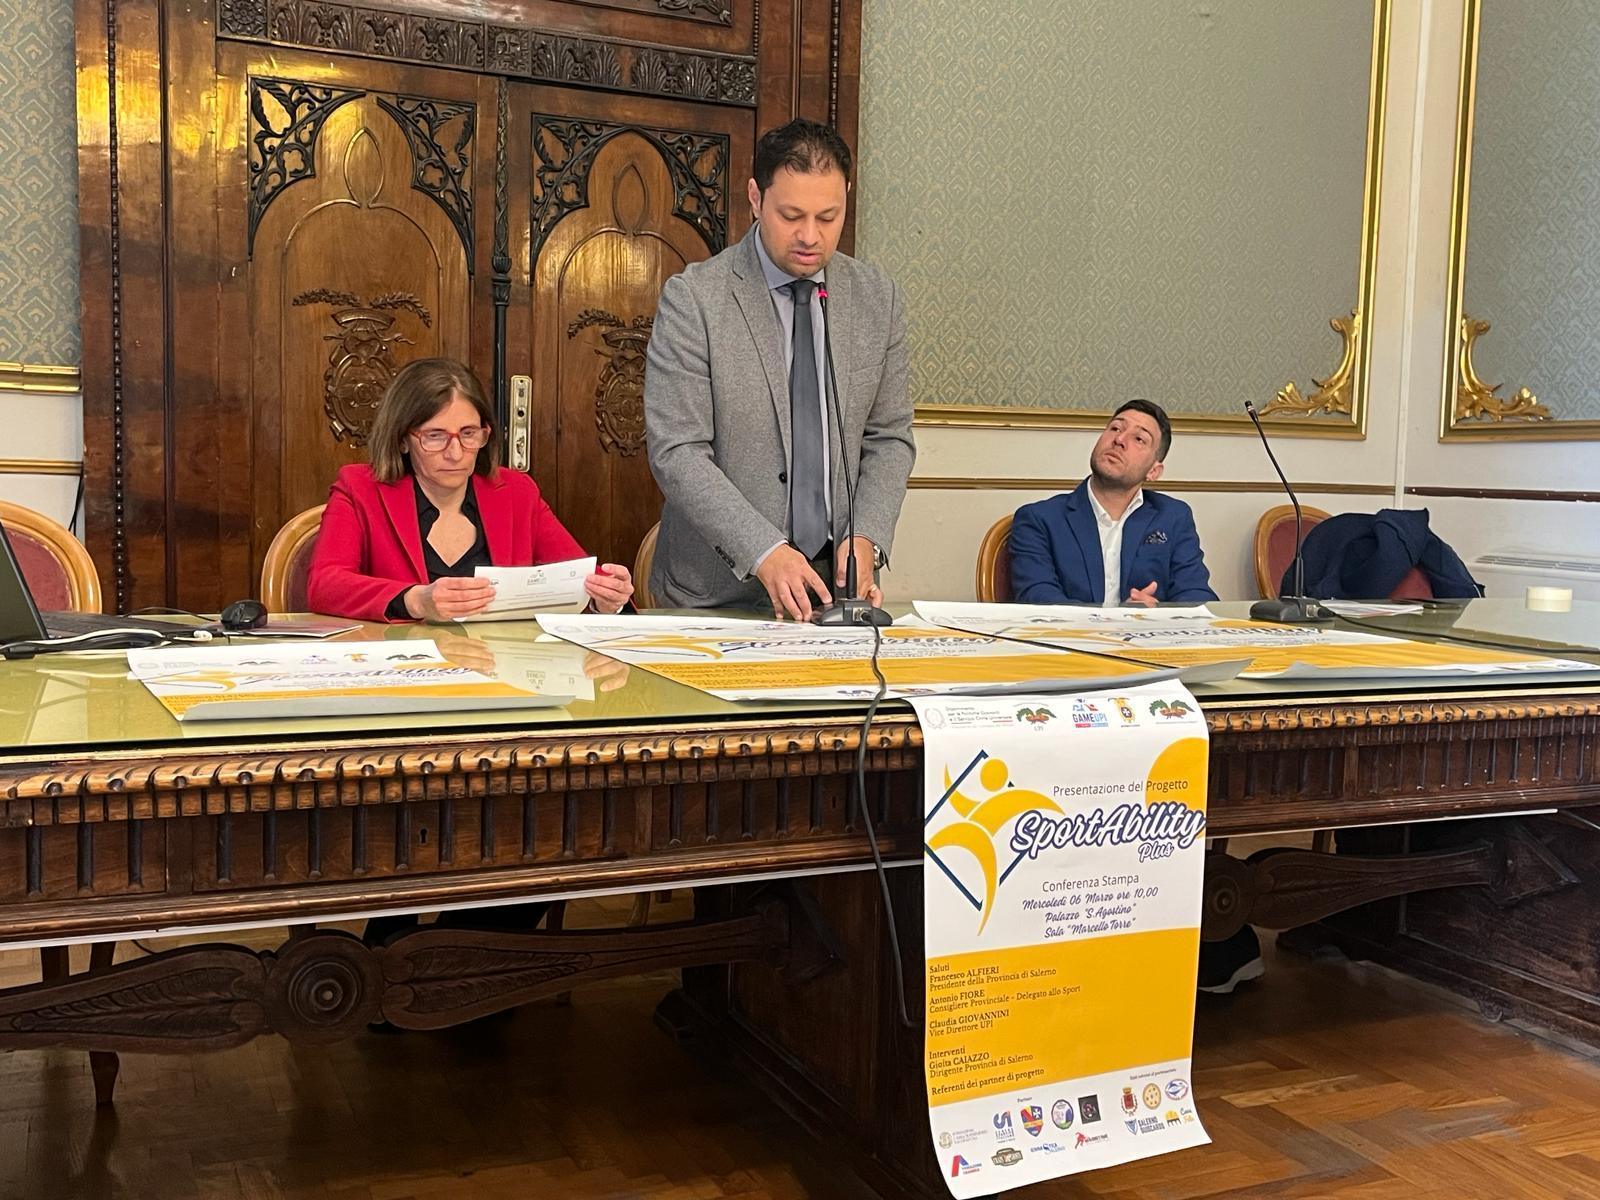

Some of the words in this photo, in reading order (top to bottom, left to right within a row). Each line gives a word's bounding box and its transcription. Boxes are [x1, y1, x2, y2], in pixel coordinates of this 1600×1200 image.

[1053, 783, 1125, 797] Presentazione
[1128, 781, 1143, 793] del
[1146, 779, 1188, 793] Progetto
[1009, 800, 1207, 861] SportAbility
[1137, 841, 1174, 863] Plus
[1042, 879, 1099, 893] Conferenza
[1102, 874, 1139, 887] Stampa
[1069, 895, 1081, 905] 06
[1085, 892, 1113, 904] Marzo
[1116, 890, 1130, 899] ore
[1045, 911, 1080, 923] Palazzo
[1044, 926, 1065, 938] Sala
[929, 963, 950, 974] Saluti
[929, 972, 965, 984] Francesco
[966, 966, 1000, 978] ALFIERI
[929, 980, 966, 992] Presidente
[967, 977, 985, 986] della
[986, 973, 1020, 984] Provincia
[1020, 971, 1029, 979] di
[1030, 967, 1057, 978] Salerno
[929, 993, 959, 1006] Antonio
[960, 989, 985, 1001] FIORE
[929, 1001, 969, 1014] Consigliere
[970, 993, 1010, 1008] Provinciale
[1016, 989, 1048, 1001] Delegato
[1048, 987, 1062, 996] allo
[1062, 985, 1081, 996] Sport
[929, 1017, 957, 1030] Claudia
[958, 1009, 1010, 1024] GIOVANNINI
[929, 1029, 945, 1038] Vice
[946, 1023, 979, 1035] Direttore
[980, 1020, 994, 1029] UPI
[929, 1045, 966, 1060] Interventi
[953, 1051, 990, 1065] CAIAZZO
[930, 1067, 963, 1079] Dirigente
[964, 1061, 998, 1072] Provincia
[998, 1057, 1006, 1066] di
[1007, 1053, 1034, 1064] Salerno
[931, 1081, 966, 1095] Referenti
[966, 1079, 978, 1089] dei
[979, 1075, 1005, 1088] partner
[1006, 1072, 1015, 1081] di
[1015, 1067, 1045, 1082] progetto
